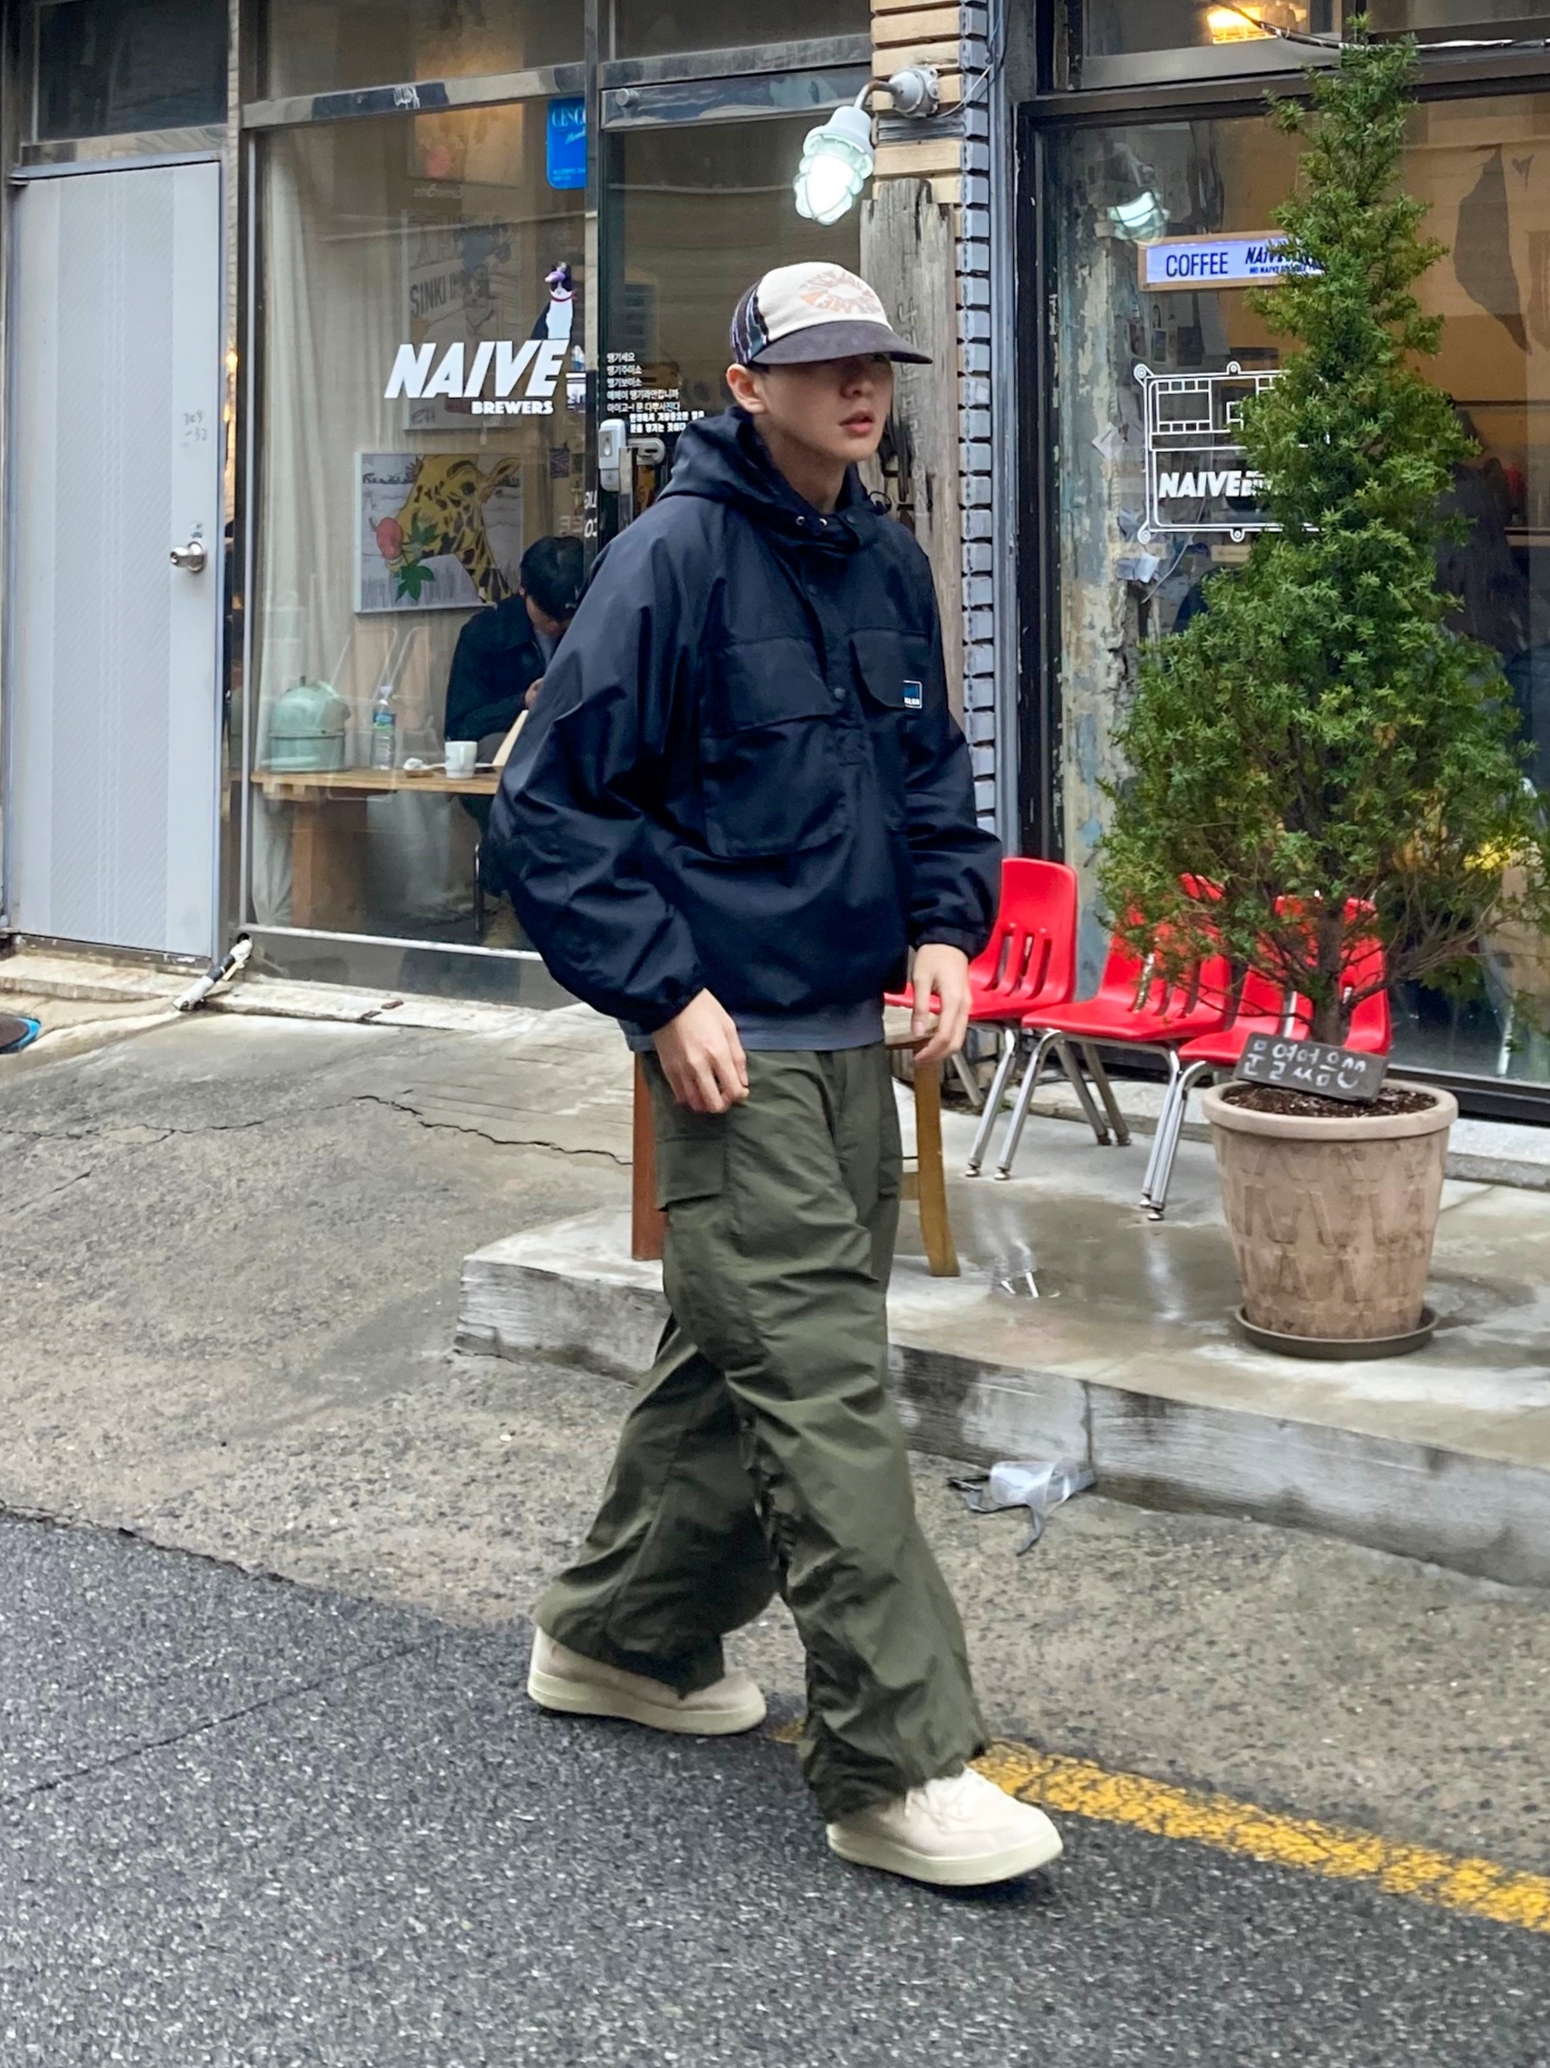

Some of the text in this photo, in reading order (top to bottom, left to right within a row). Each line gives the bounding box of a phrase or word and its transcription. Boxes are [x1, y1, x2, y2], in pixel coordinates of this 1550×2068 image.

[1166, 252, 1229, 278] COFFEE
[384, 339, 570, 399] NAIVE
[471, 400, 554, 415] BREWERS
[1158, 470, 1242, 498] NAIVE
